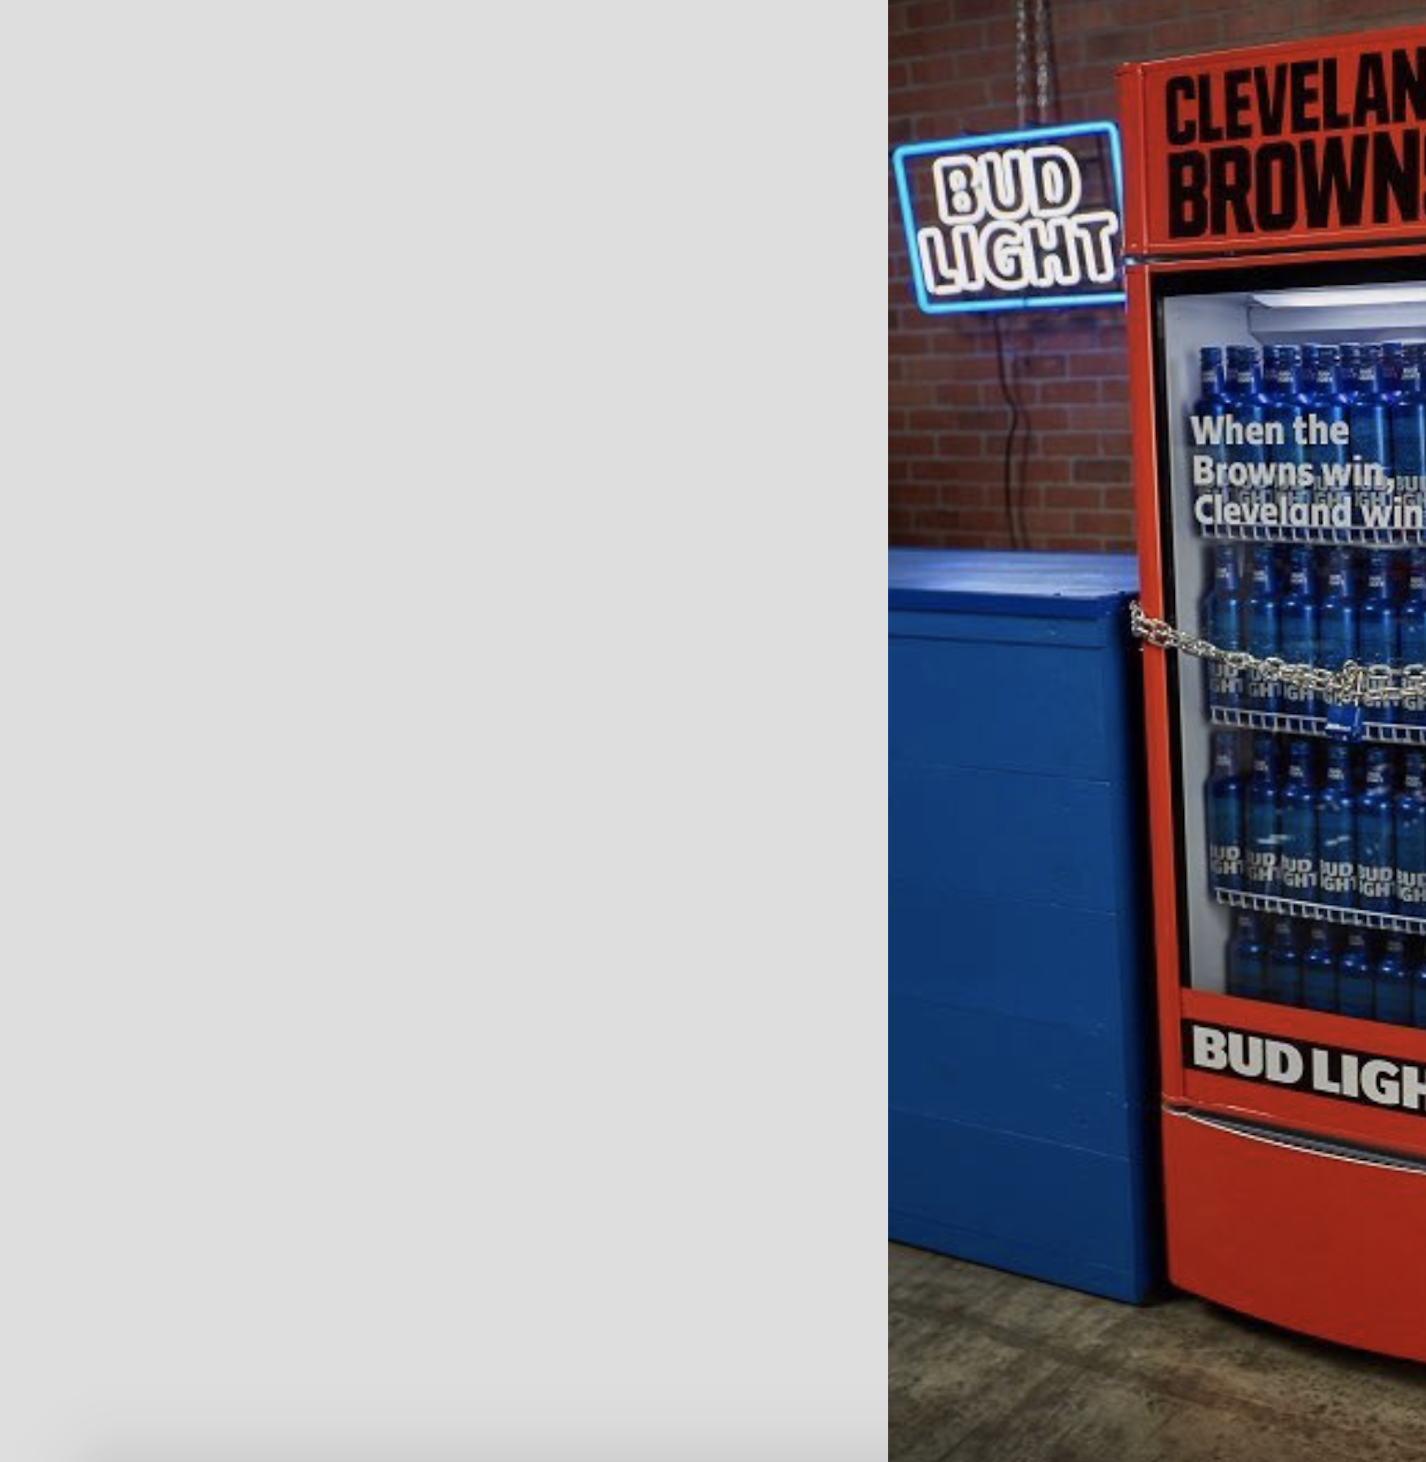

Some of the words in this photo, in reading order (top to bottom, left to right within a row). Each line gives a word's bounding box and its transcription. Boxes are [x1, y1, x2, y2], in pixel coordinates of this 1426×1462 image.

[932, 145, 1082, 226] BUD
[917, 210, 1118, 295] LIGHT
[1190, 414, 1286, 446] When
[1293, 413, 1350, 446] the
[1192, 455, 1314, 488] Browns
[1321, 455, 1396, 494] win,
[1195, 493, 1352, 527] Cleveland
[1193, 1024, 1305, 1084] BUD
